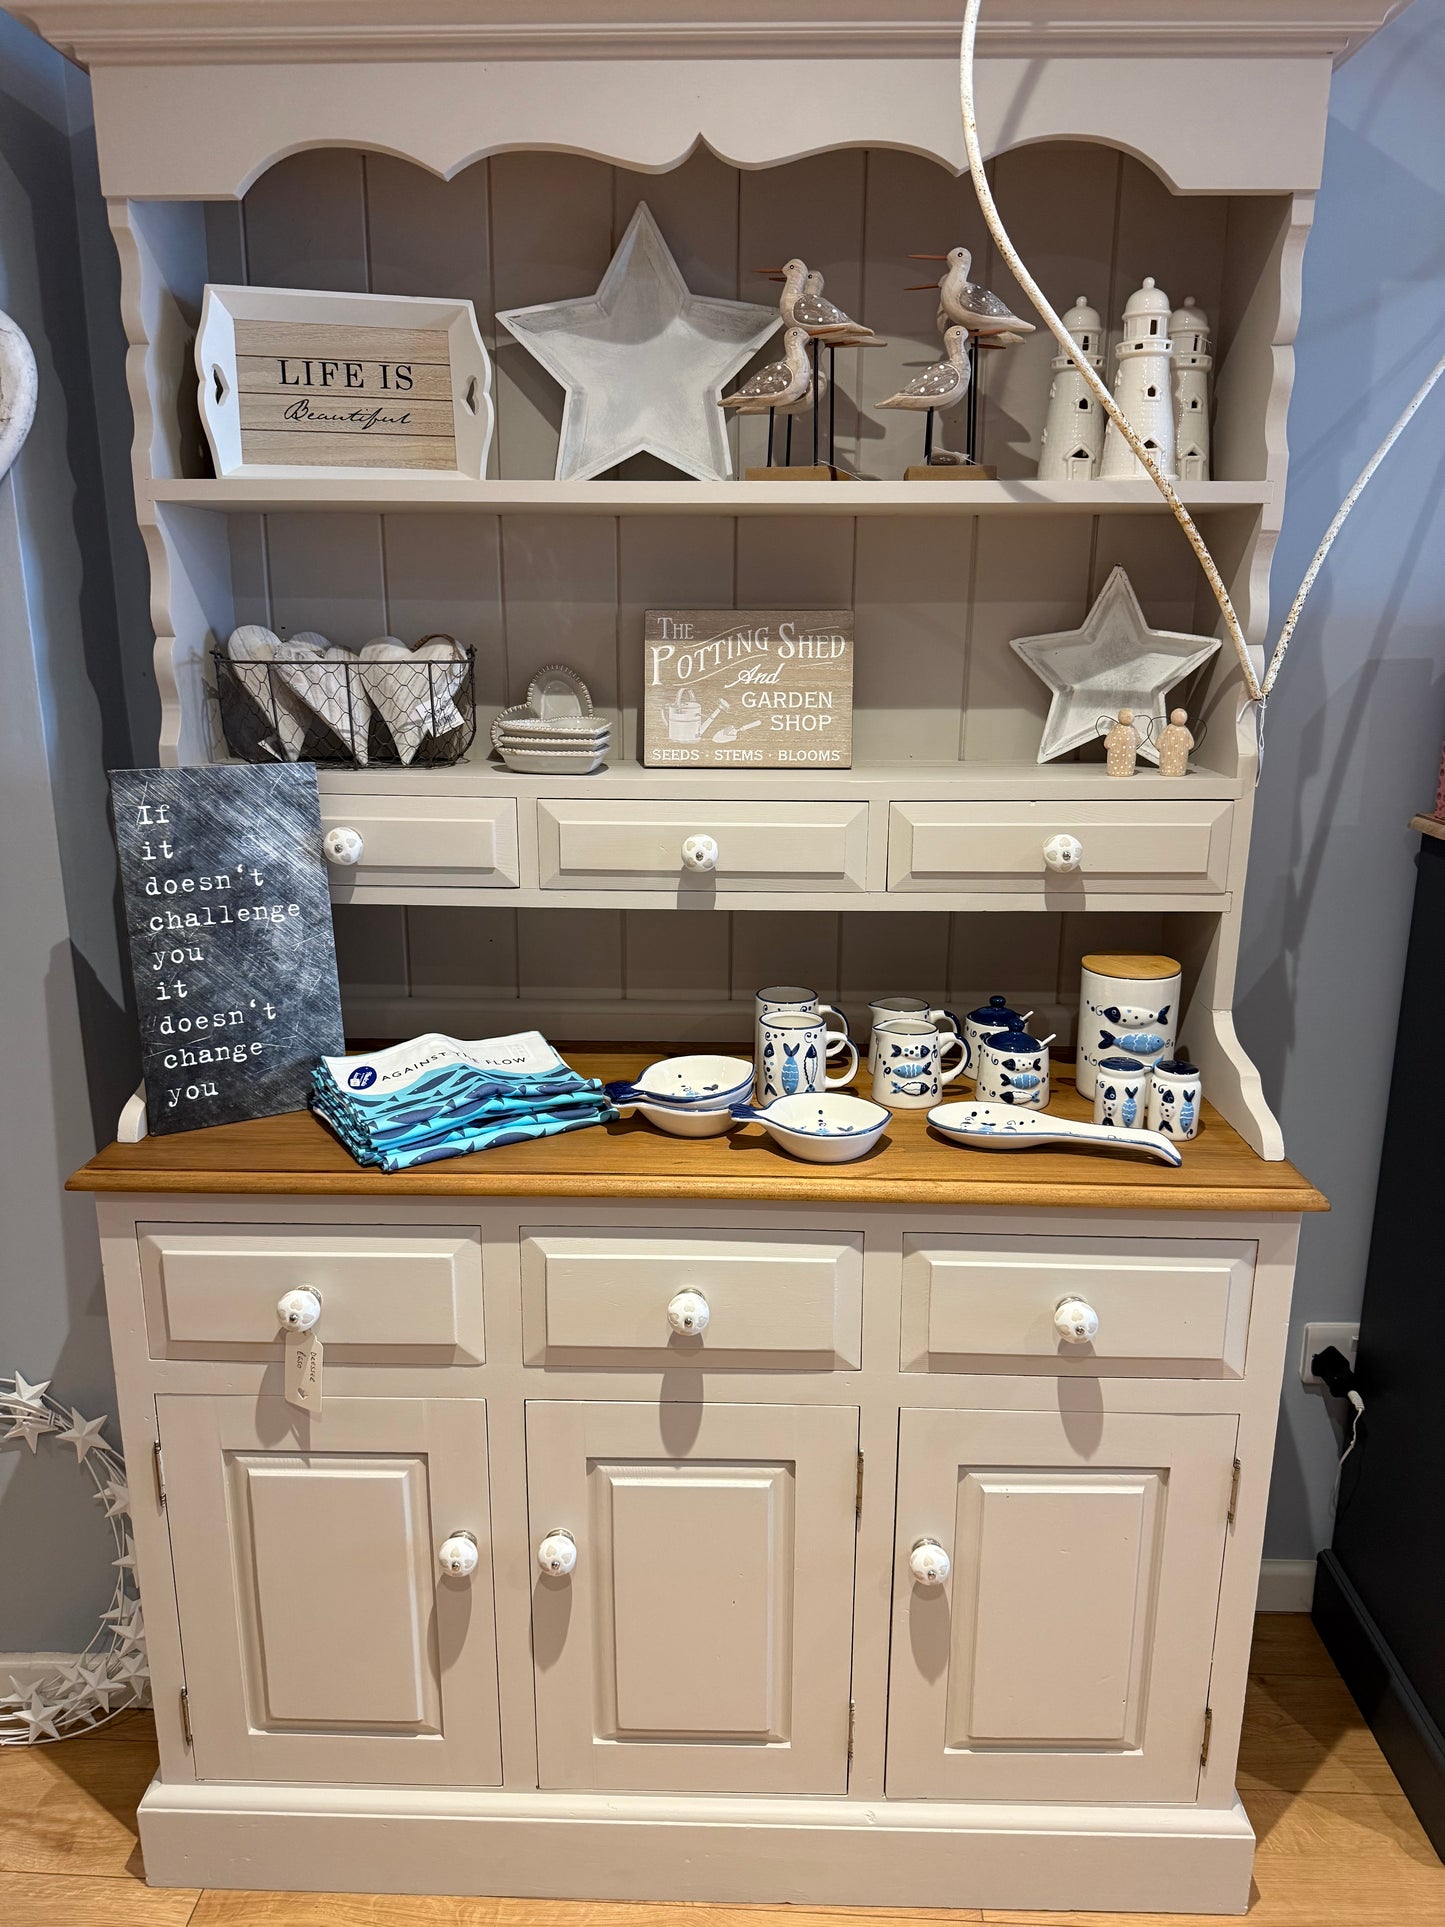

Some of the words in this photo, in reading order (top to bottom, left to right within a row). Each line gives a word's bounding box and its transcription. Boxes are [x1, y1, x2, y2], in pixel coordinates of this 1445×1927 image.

[277, 359, 364, 389] LIFE
[379, 364, 414, 391] IS
[283, 398, 411, 431] Beautiful
[657, 617, 694, 640] THE
[651, 626, 769, 686] POTTING
[778, 622, 846, 659] SHED
[724, 663, 786, 688] And
[741, 691, 833, 709] GARDEN
[770, 715, 832, 731] SHOP
[652, 749, 700, 761] SEEDS
[714, 749, 763, 761] STEMS
[778, 750, 840, 761] BLOOMS
[137, 804, 170, 825] If
[141, 840, 174, 861] it
[145, 864, 264, 896] doesn't
[150, 903, 300, 932] challenge
[152, 947, 204, 971] you
[156, 979, 188, 1001] it
[160, 999, 277, 1035] doesn't
[163, 1041, 263, 1070] change
[381, 1051, 447, 1082] AGAINST
[485, 1056, 527, 1067] FLOW
[167, 1082, 219, 1108] you
